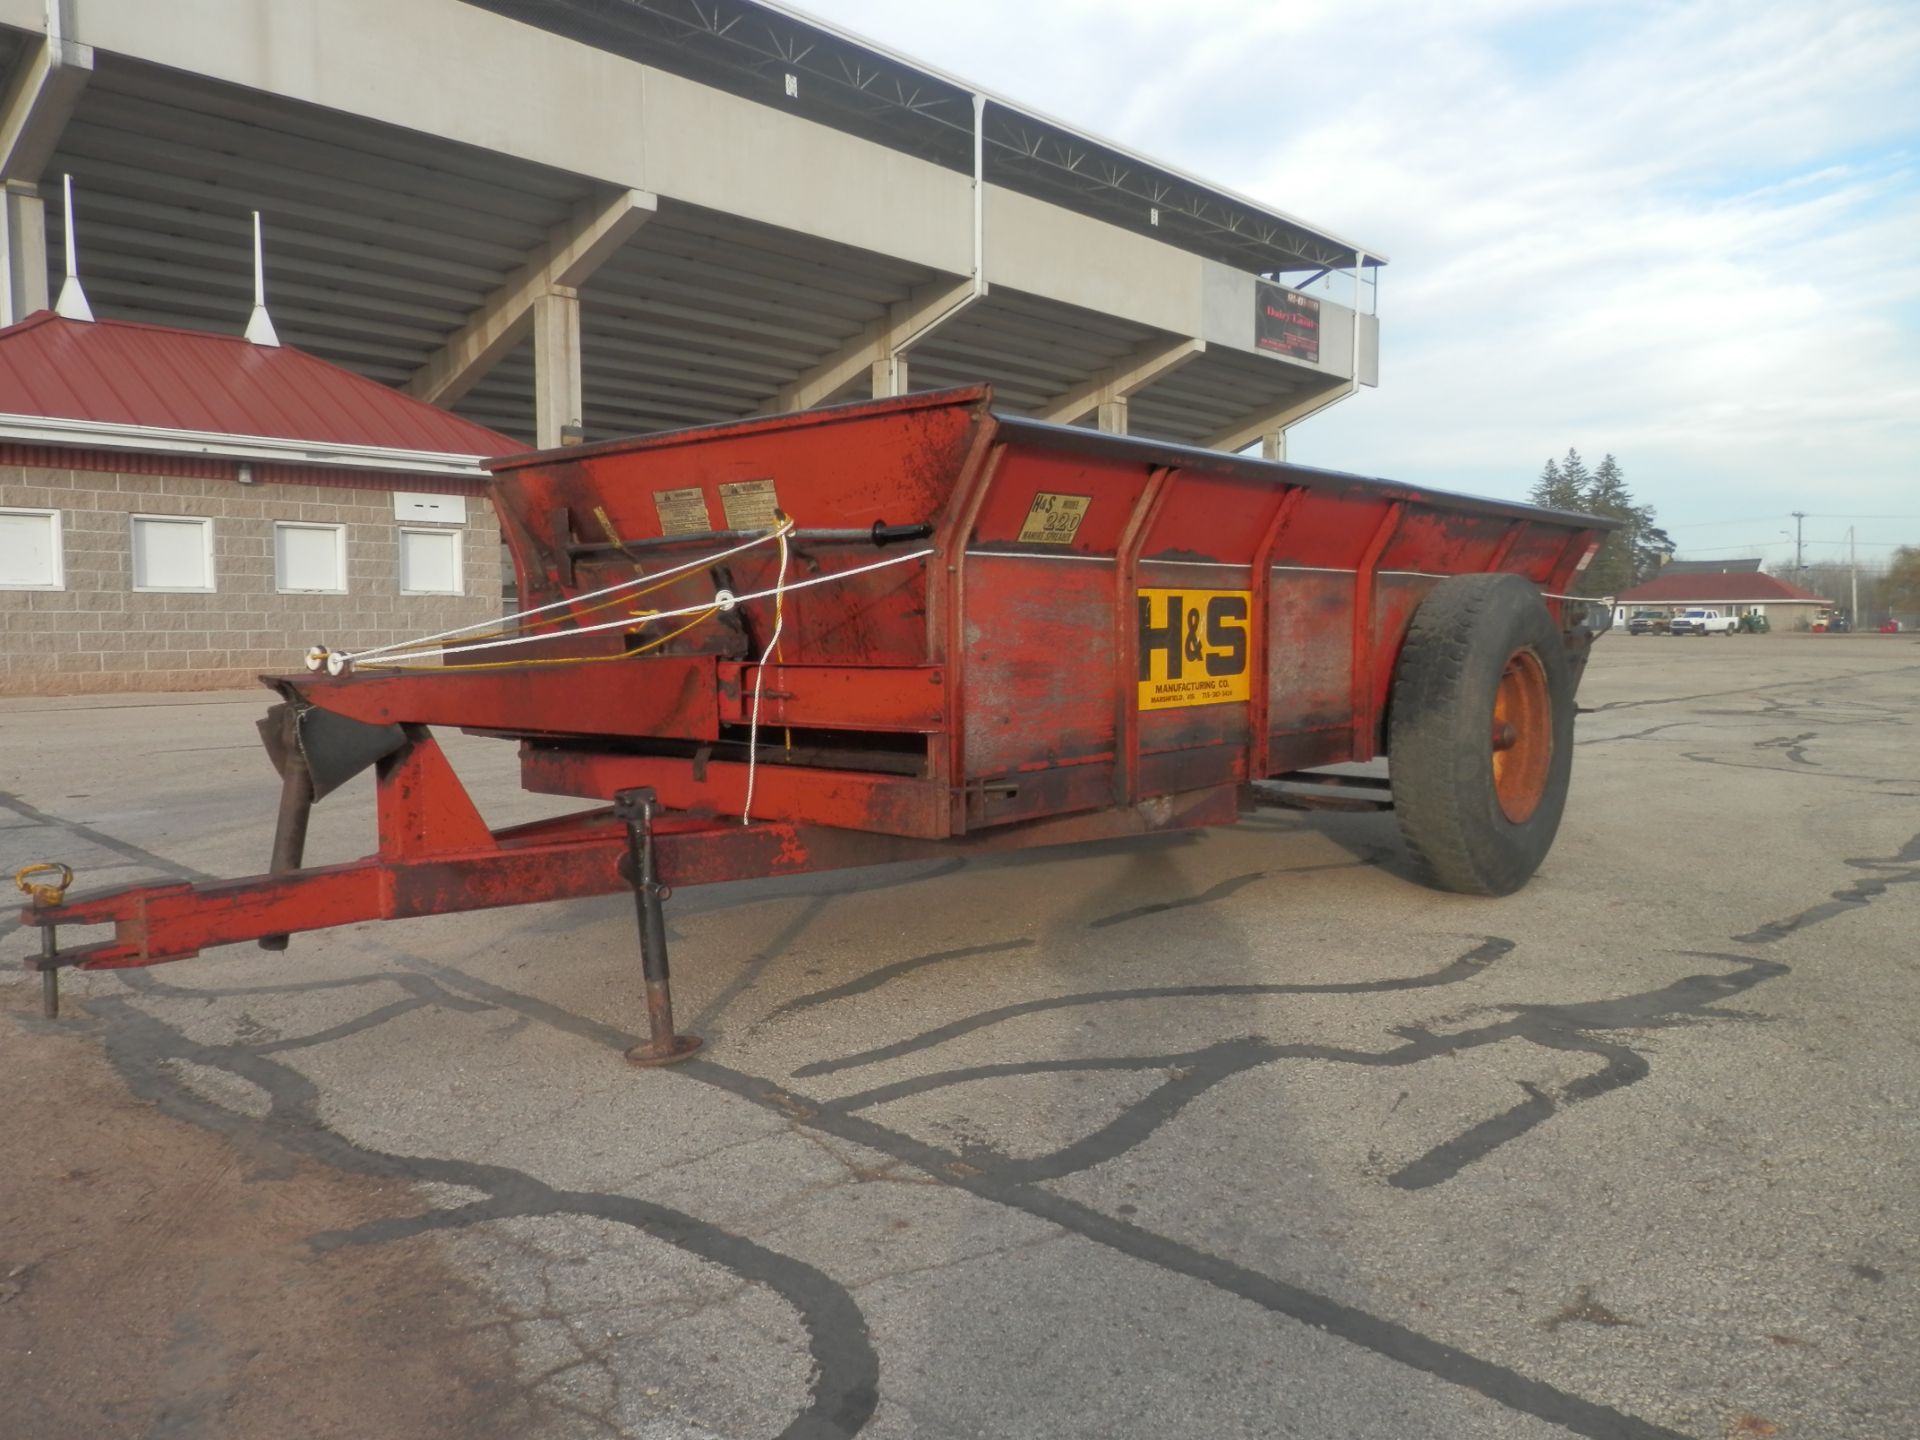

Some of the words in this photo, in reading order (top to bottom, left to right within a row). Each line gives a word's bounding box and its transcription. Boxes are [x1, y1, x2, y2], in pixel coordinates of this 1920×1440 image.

[1032, 495, 1056, 513] H&S
[1043, 511, 1081, 532] 220
[1138, 595, 1247, 681] H&S
[1155, 680, 1216, 694] MANUFACTURING
[1218, 679, 1230, 688] CO.
